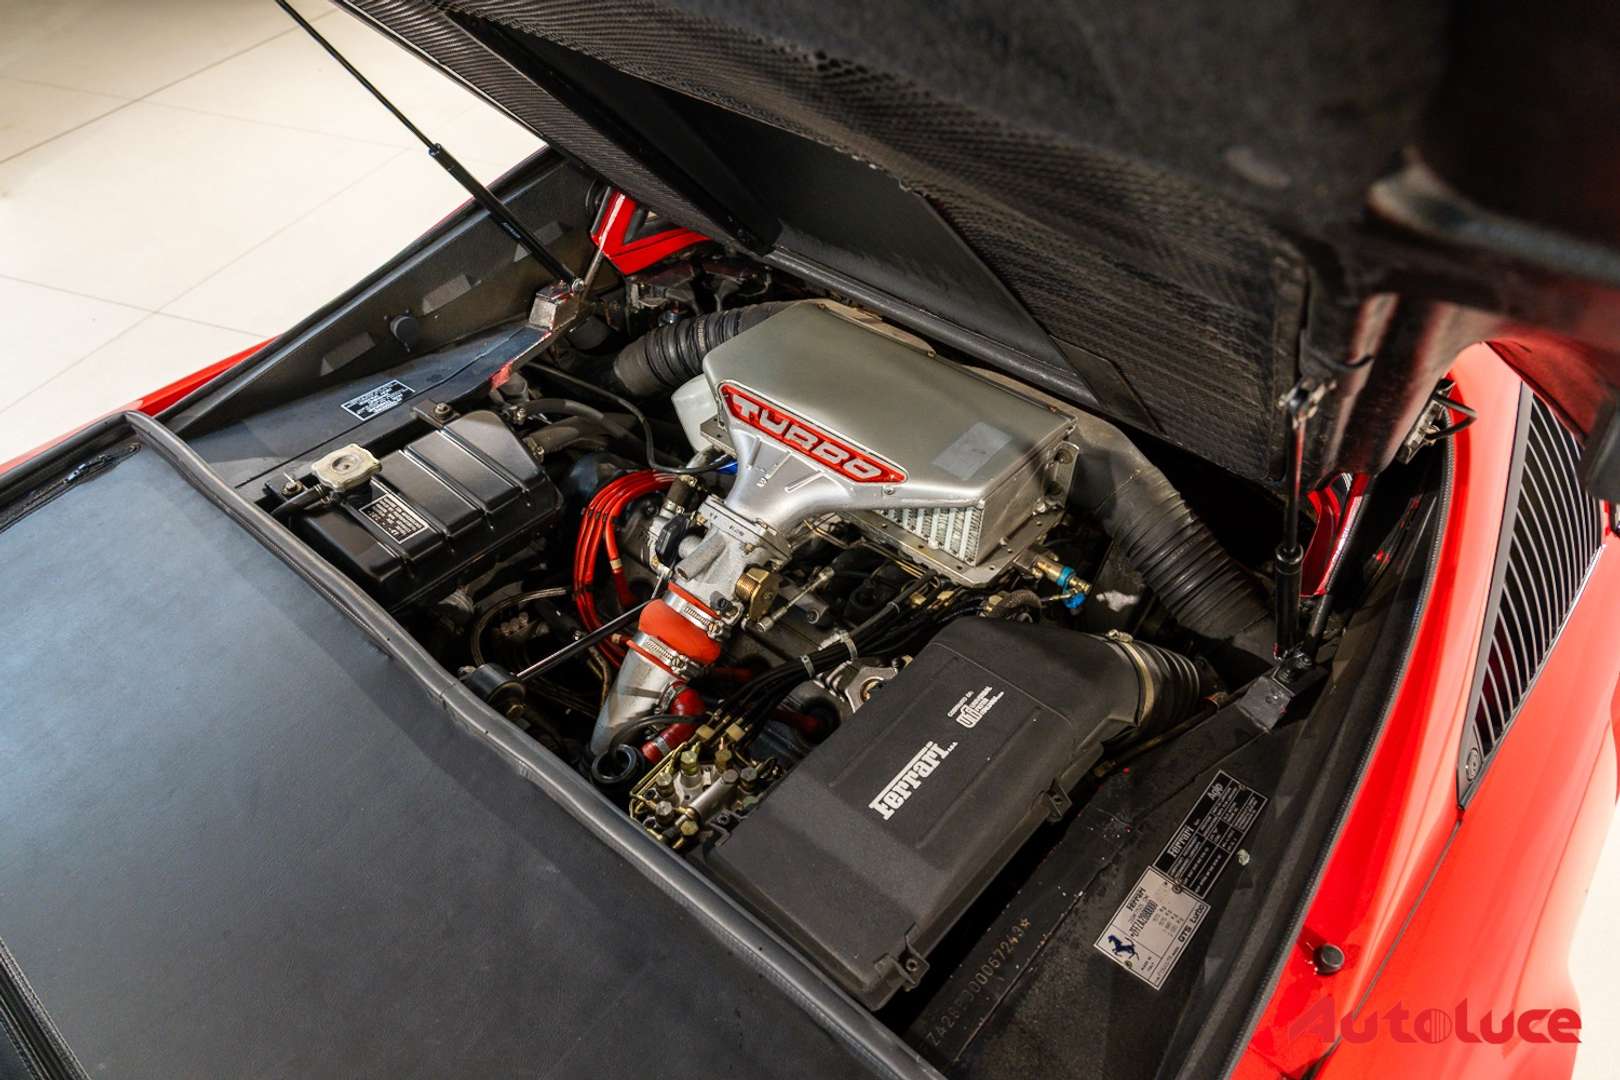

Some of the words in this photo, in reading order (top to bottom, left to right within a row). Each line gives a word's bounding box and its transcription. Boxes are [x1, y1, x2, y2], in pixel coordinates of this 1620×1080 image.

[731, 394, 882, 480] TURBO
[868, 741, 949, 820] Ferrari
[1167, 825, 1195, 858] Ferrari
